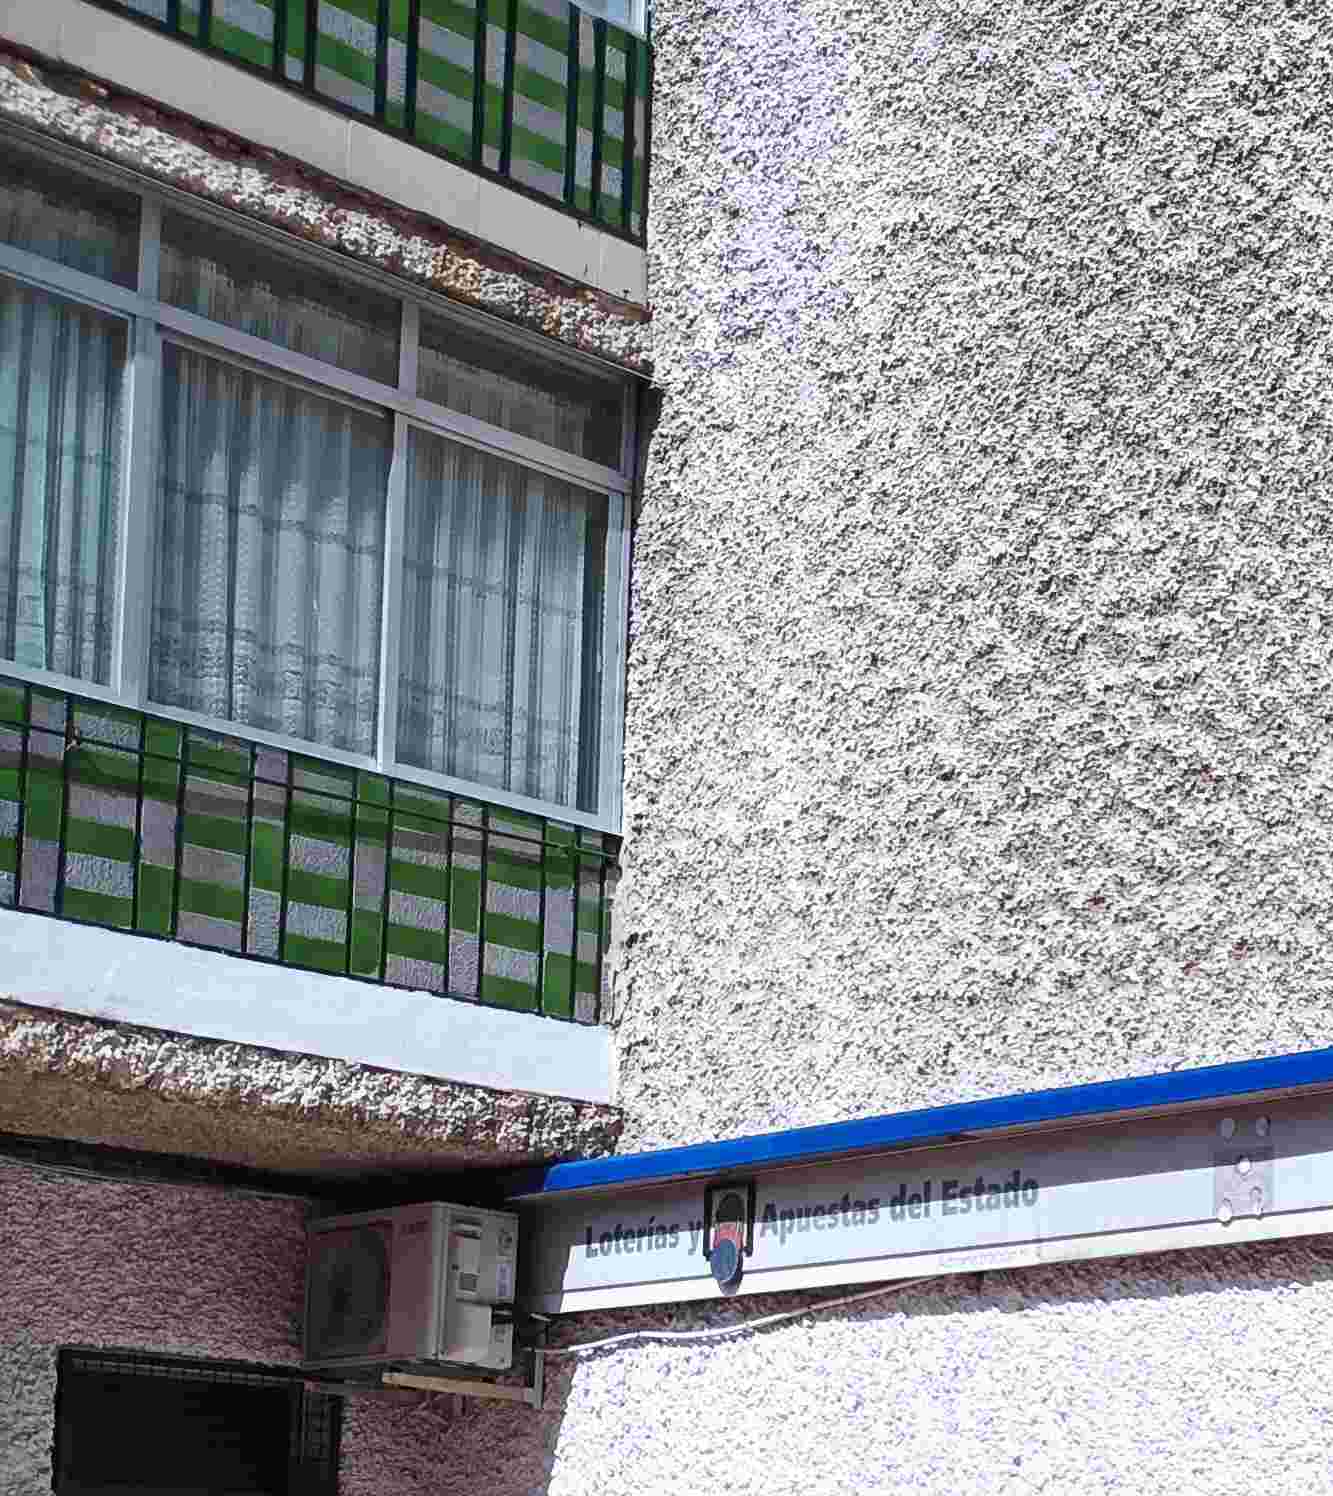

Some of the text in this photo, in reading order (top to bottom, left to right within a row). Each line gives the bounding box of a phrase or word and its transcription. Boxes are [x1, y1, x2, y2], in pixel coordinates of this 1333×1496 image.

[585, 1215, 680, 1259] Loterías
[760, 1169, 1040, 1246] Apuestas del Estado
